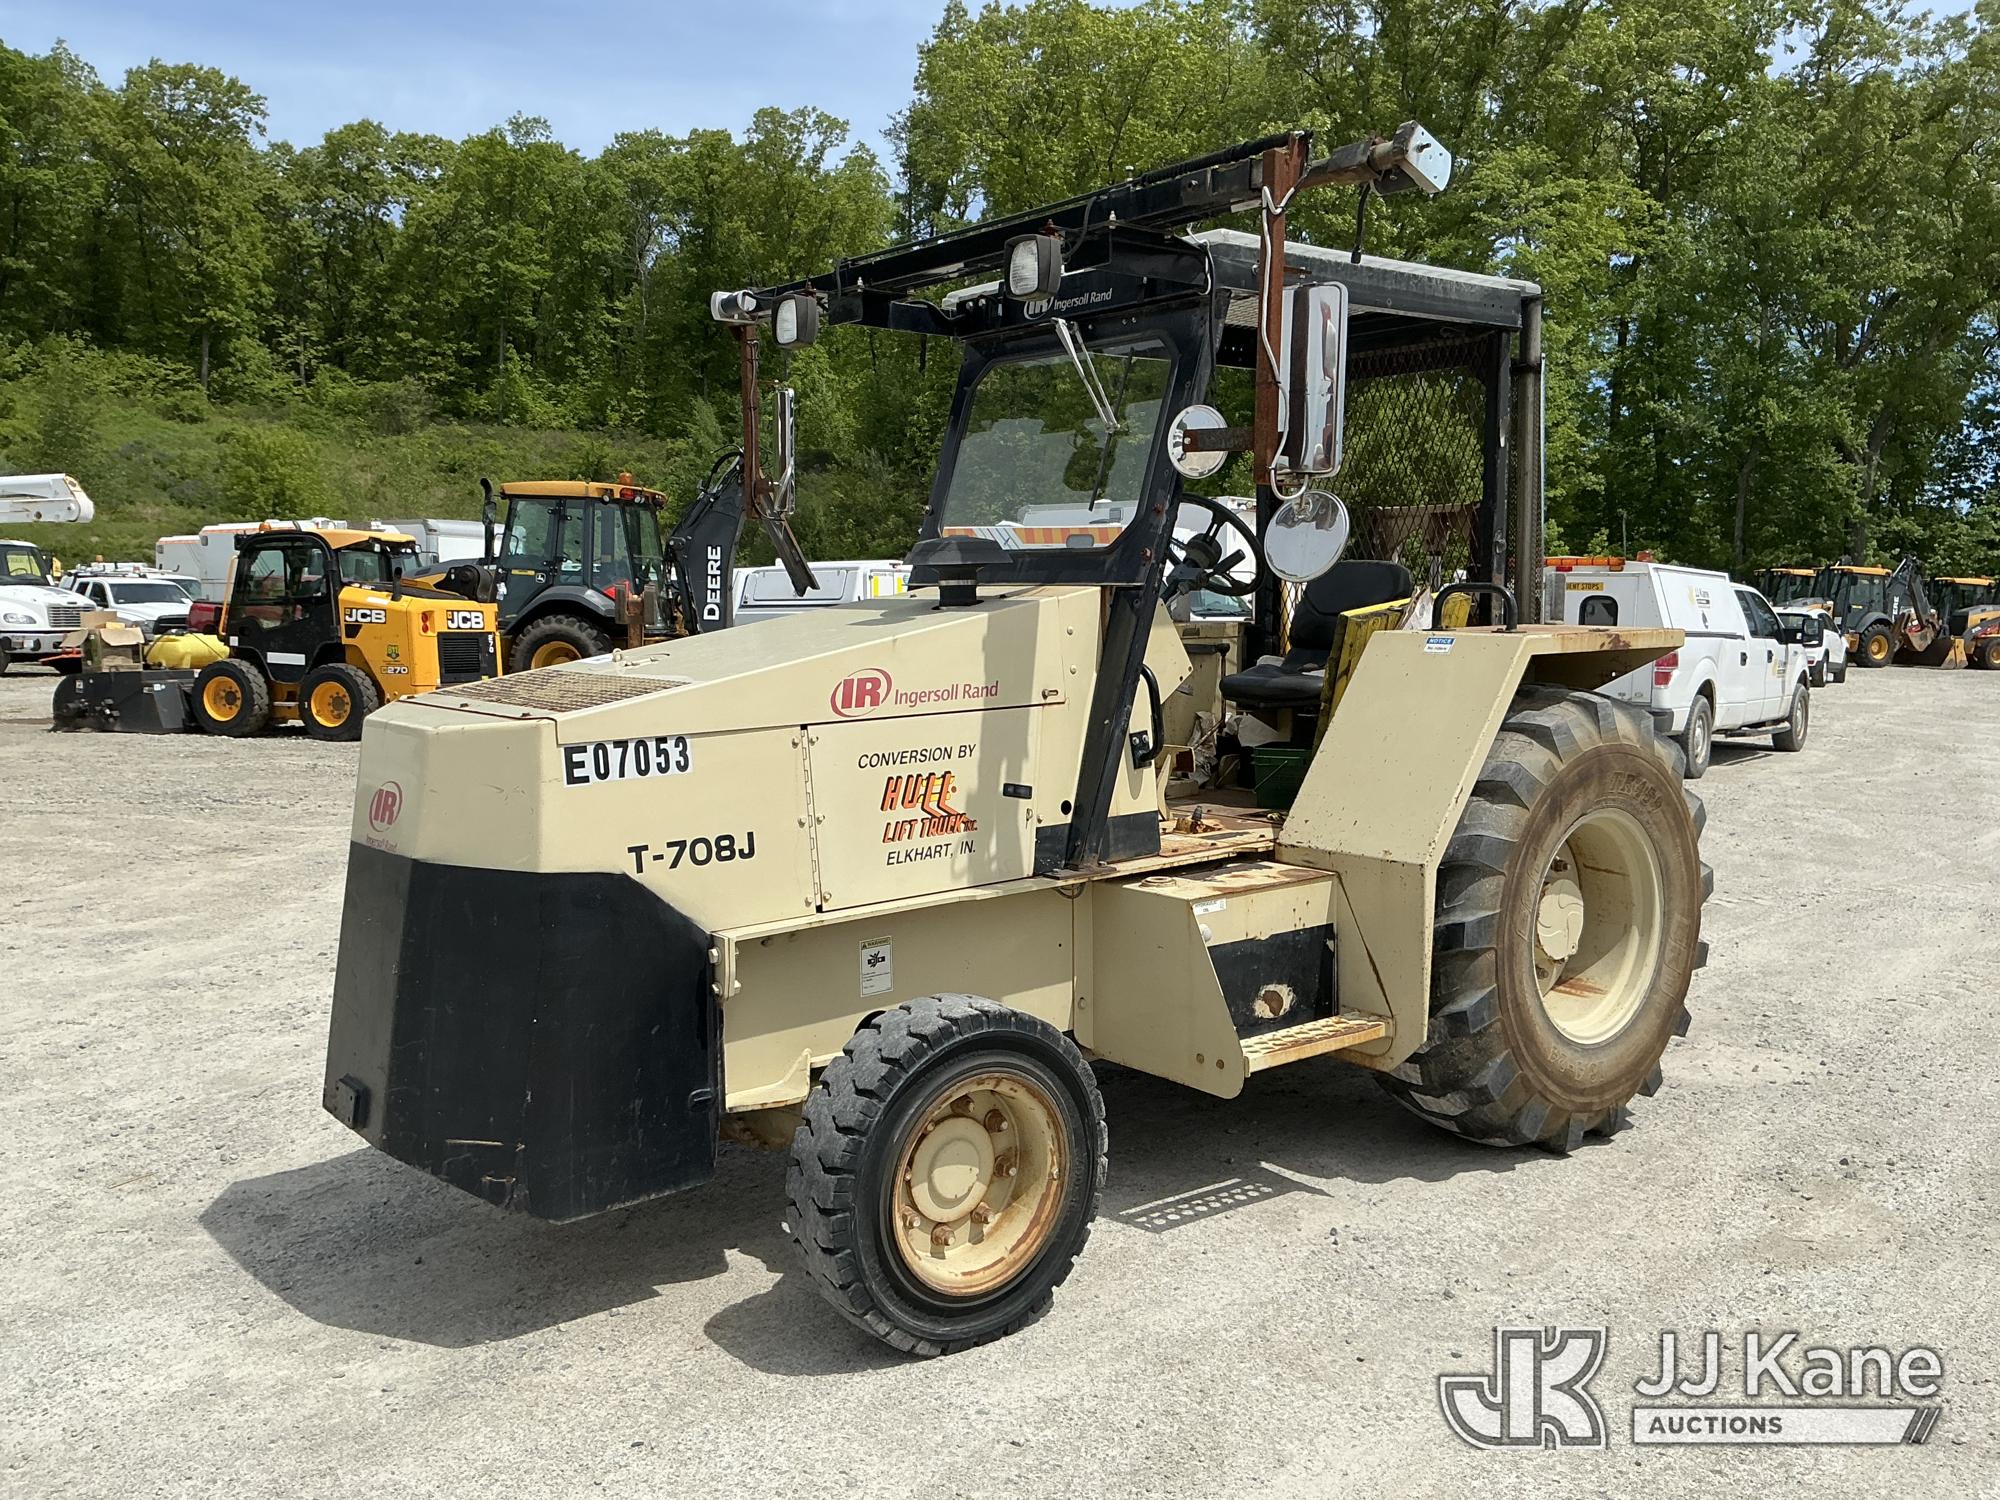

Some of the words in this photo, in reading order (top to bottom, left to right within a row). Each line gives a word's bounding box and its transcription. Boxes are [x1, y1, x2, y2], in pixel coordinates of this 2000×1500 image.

[1054, 292, 1088, 311] Ingersoll
[1090, 287, 1113, 303] Rand
[703, 546, 721, 620] DEERE
[345, 609, 386, 623] JCB
[446, 611, 484, 629] JCB
[894, 683, 959, 708] Ingersoll
[962, 680, 999, 699] Rand
[563, 736, 690, 785] E07053
[858, 746, 953, 769] CONVERSION
[957, 744, 977, 759] BY
[880, 771, 960, 818] HULL
[882, 817, 919, 844] LIFT
[919, 813, 967, 839] TRUCK
[627, 831, 756, 874] T-708J
[886, 843, 954, 866] ELKHART,
[959, 840, 977, 855] IN.
